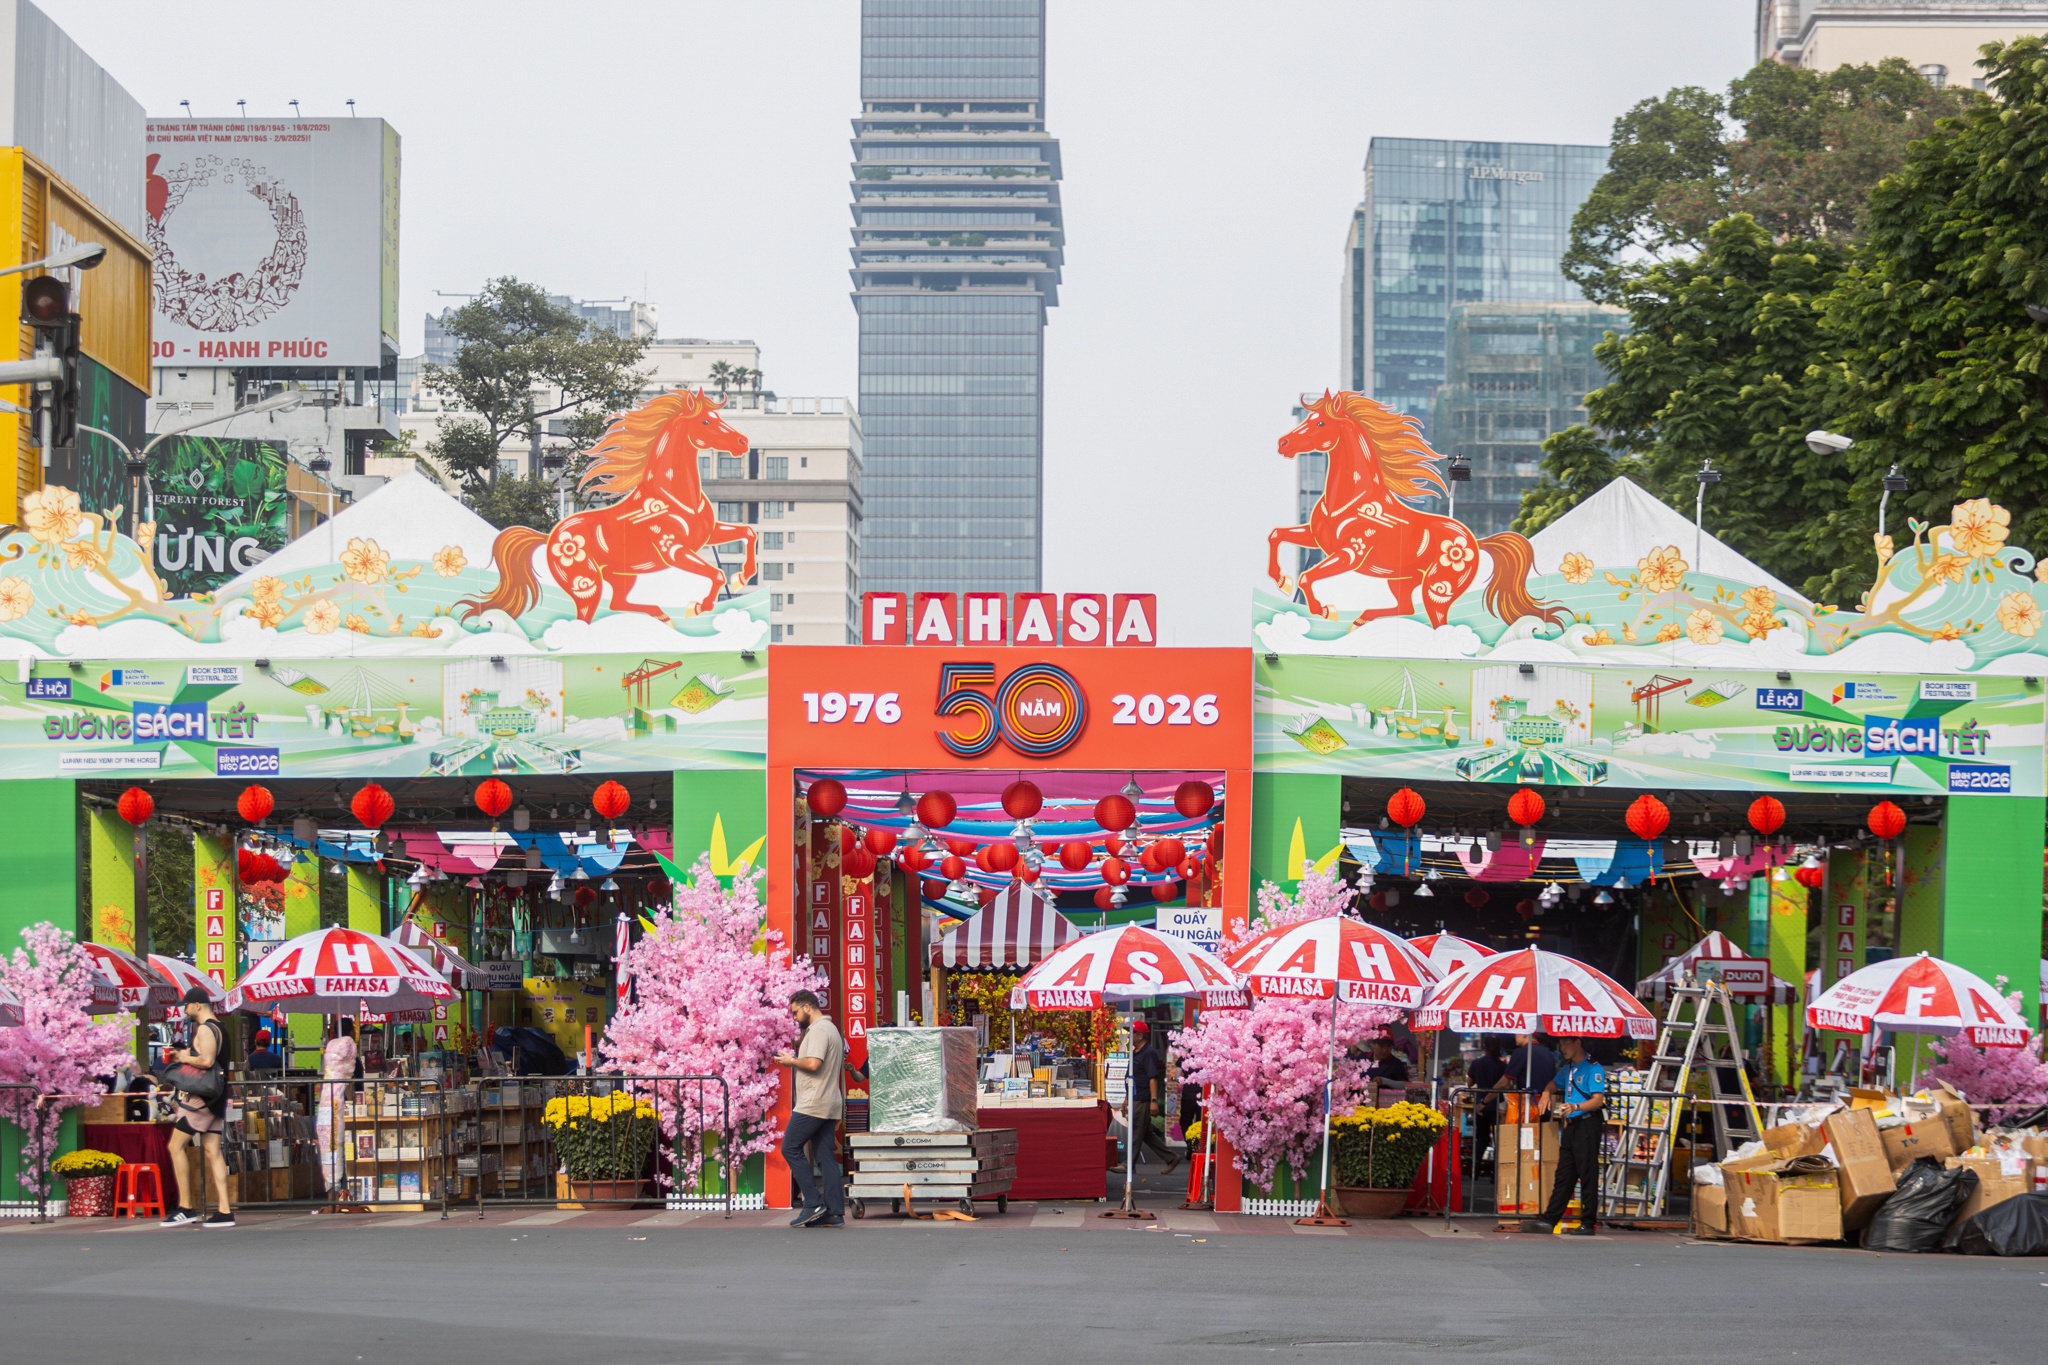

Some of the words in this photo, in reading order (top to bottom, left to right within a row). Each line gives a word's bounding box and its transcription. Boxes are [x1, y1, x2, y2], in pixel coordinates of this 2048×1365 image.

[156, 123, 180, 132] THÁNG
[182, 122, 198, 132] TÁM
[225, 122, 245, 132] CÔNG
[199, 341, 260, 362] HẠNH
[268, 337, 328, 358] PHÚC
[153, 494, 198, 504] ETREAT
[202, 496, 246, 507] FOREST
[870, 596, 1154, 643] FAHASA
[29, 678, 45, 695] LỄ
[46, 681, 67, 697] HỘI
[1759, 689, 1775, 706] LỄ
[1777, 692, 1798, 709] HỘI
[803, 692, 902, 725] 1976
[1020, 698, 1062, 718] NĂM
[1111, 692, 1220, 726] 2026
[42, 708, 132, 740] ĐƯỜNG
[135, 705, 205, 739] SÁCH
[210, 701, 260, 739] TẾT
[1772, 720, 1863, 753] ĐƯỜNG
[1867, 720, 1937, 753] SÁCH
[1942, 717, 1991, 755] TẾT
[239, 754, 280, 771] 2026
[1970, 772, 2010, 788] 2026
[1173, 909, 1208, 925] QUẦY
[1187, 927, 1222, 940] NGÂN
[813, 884, 829, 1008] FAHAS
[850, 898, 866, 1037] FAHASA
[251, 978, 309, 999] FAHASA
[325, 978, 390, 993] FAHASA
[1260, 976, 1324, 997] FAHASA
[1348, 982, 1412, 1004] FAHASA
[1037, 990, 1094, 1007] FAHASA
[1206, 990, 1249, 1008] FAHASA
[399, 1010, 427, 1021] FAHASA
[1414, 1010, 1442, 1028] FAHASA
[1461, 1011, 1527, 1029] FAHASA
[1816, 1008, 1864, 1032] FAHASA
[1552, 1016, 1617, 1034] FAHASA
[1630, 1018, 1655, 1036] FAHASA
[1974, 1027, 2024, 1045] FAHASA
